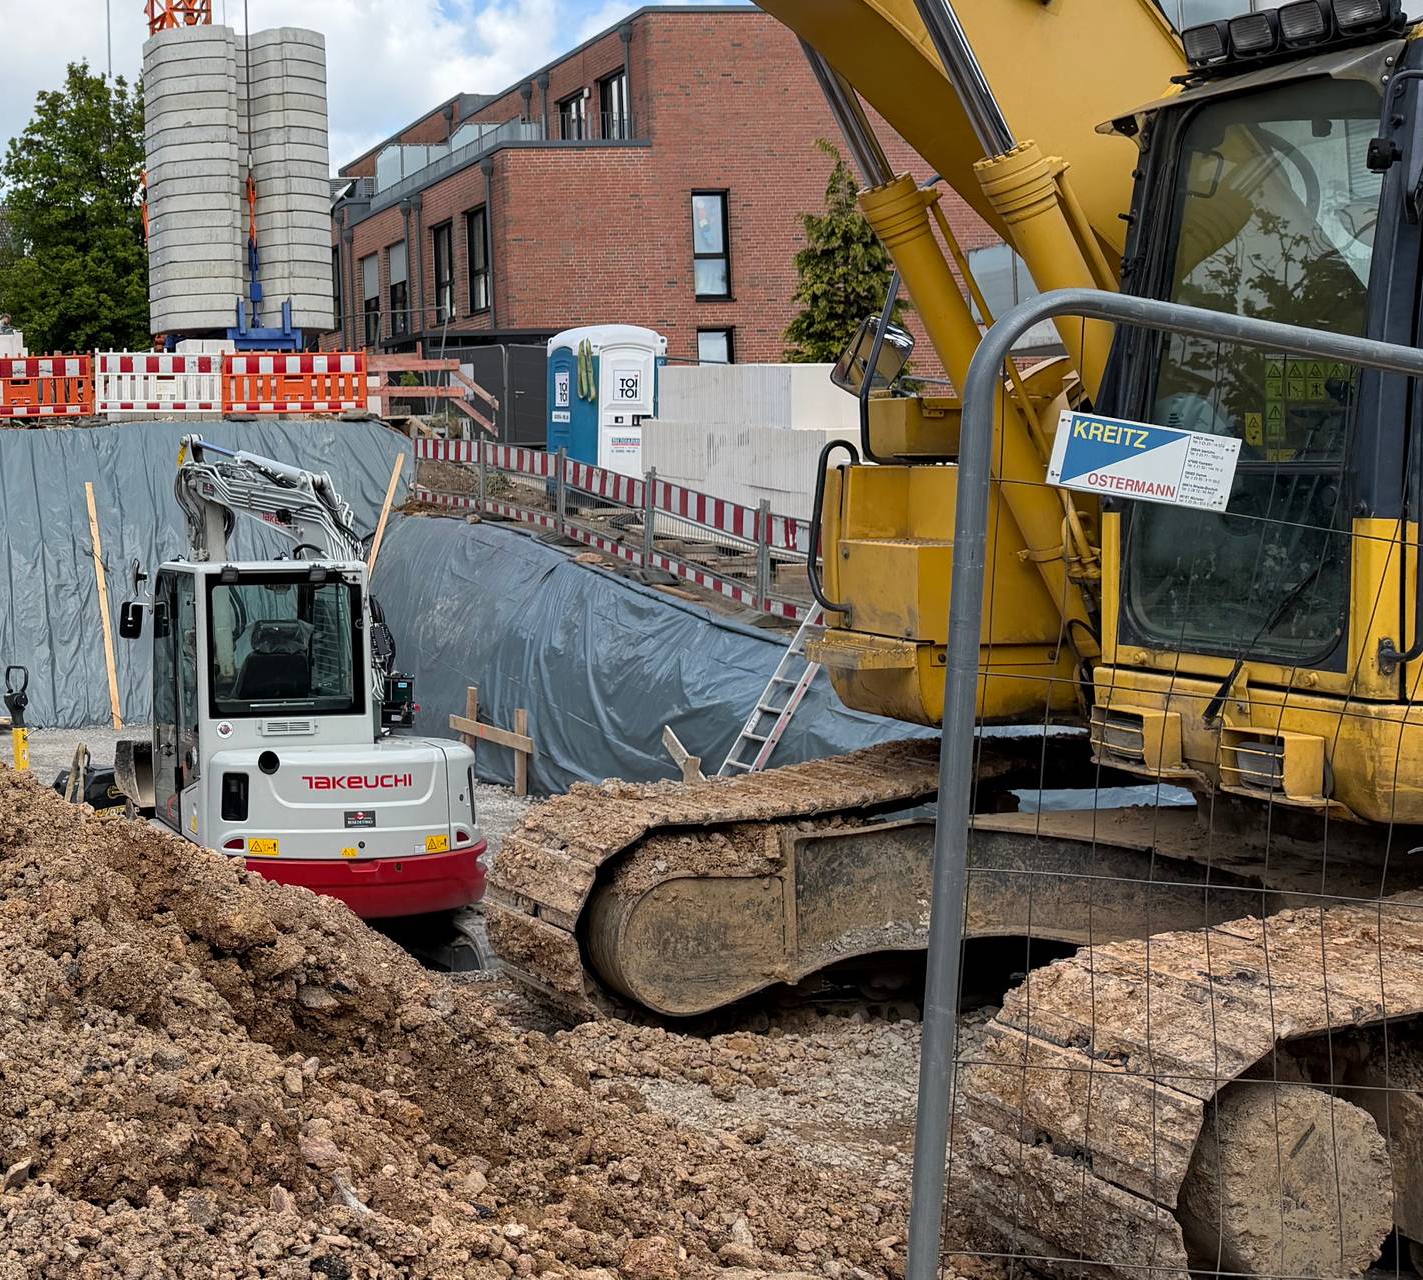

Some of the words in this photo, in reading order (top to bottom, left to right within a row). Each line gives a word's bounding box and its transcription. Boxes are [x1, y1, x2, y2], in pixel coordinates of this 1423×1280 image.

[619, 377, 638, 388] TOI
[619, 388, 638, 399] TOI
[1073, 420, 1149, 449] KREITZ
[1087, 473, 1176, 498] OSTERMANN
[302, 773, 413, 790] TAKEUCHI
